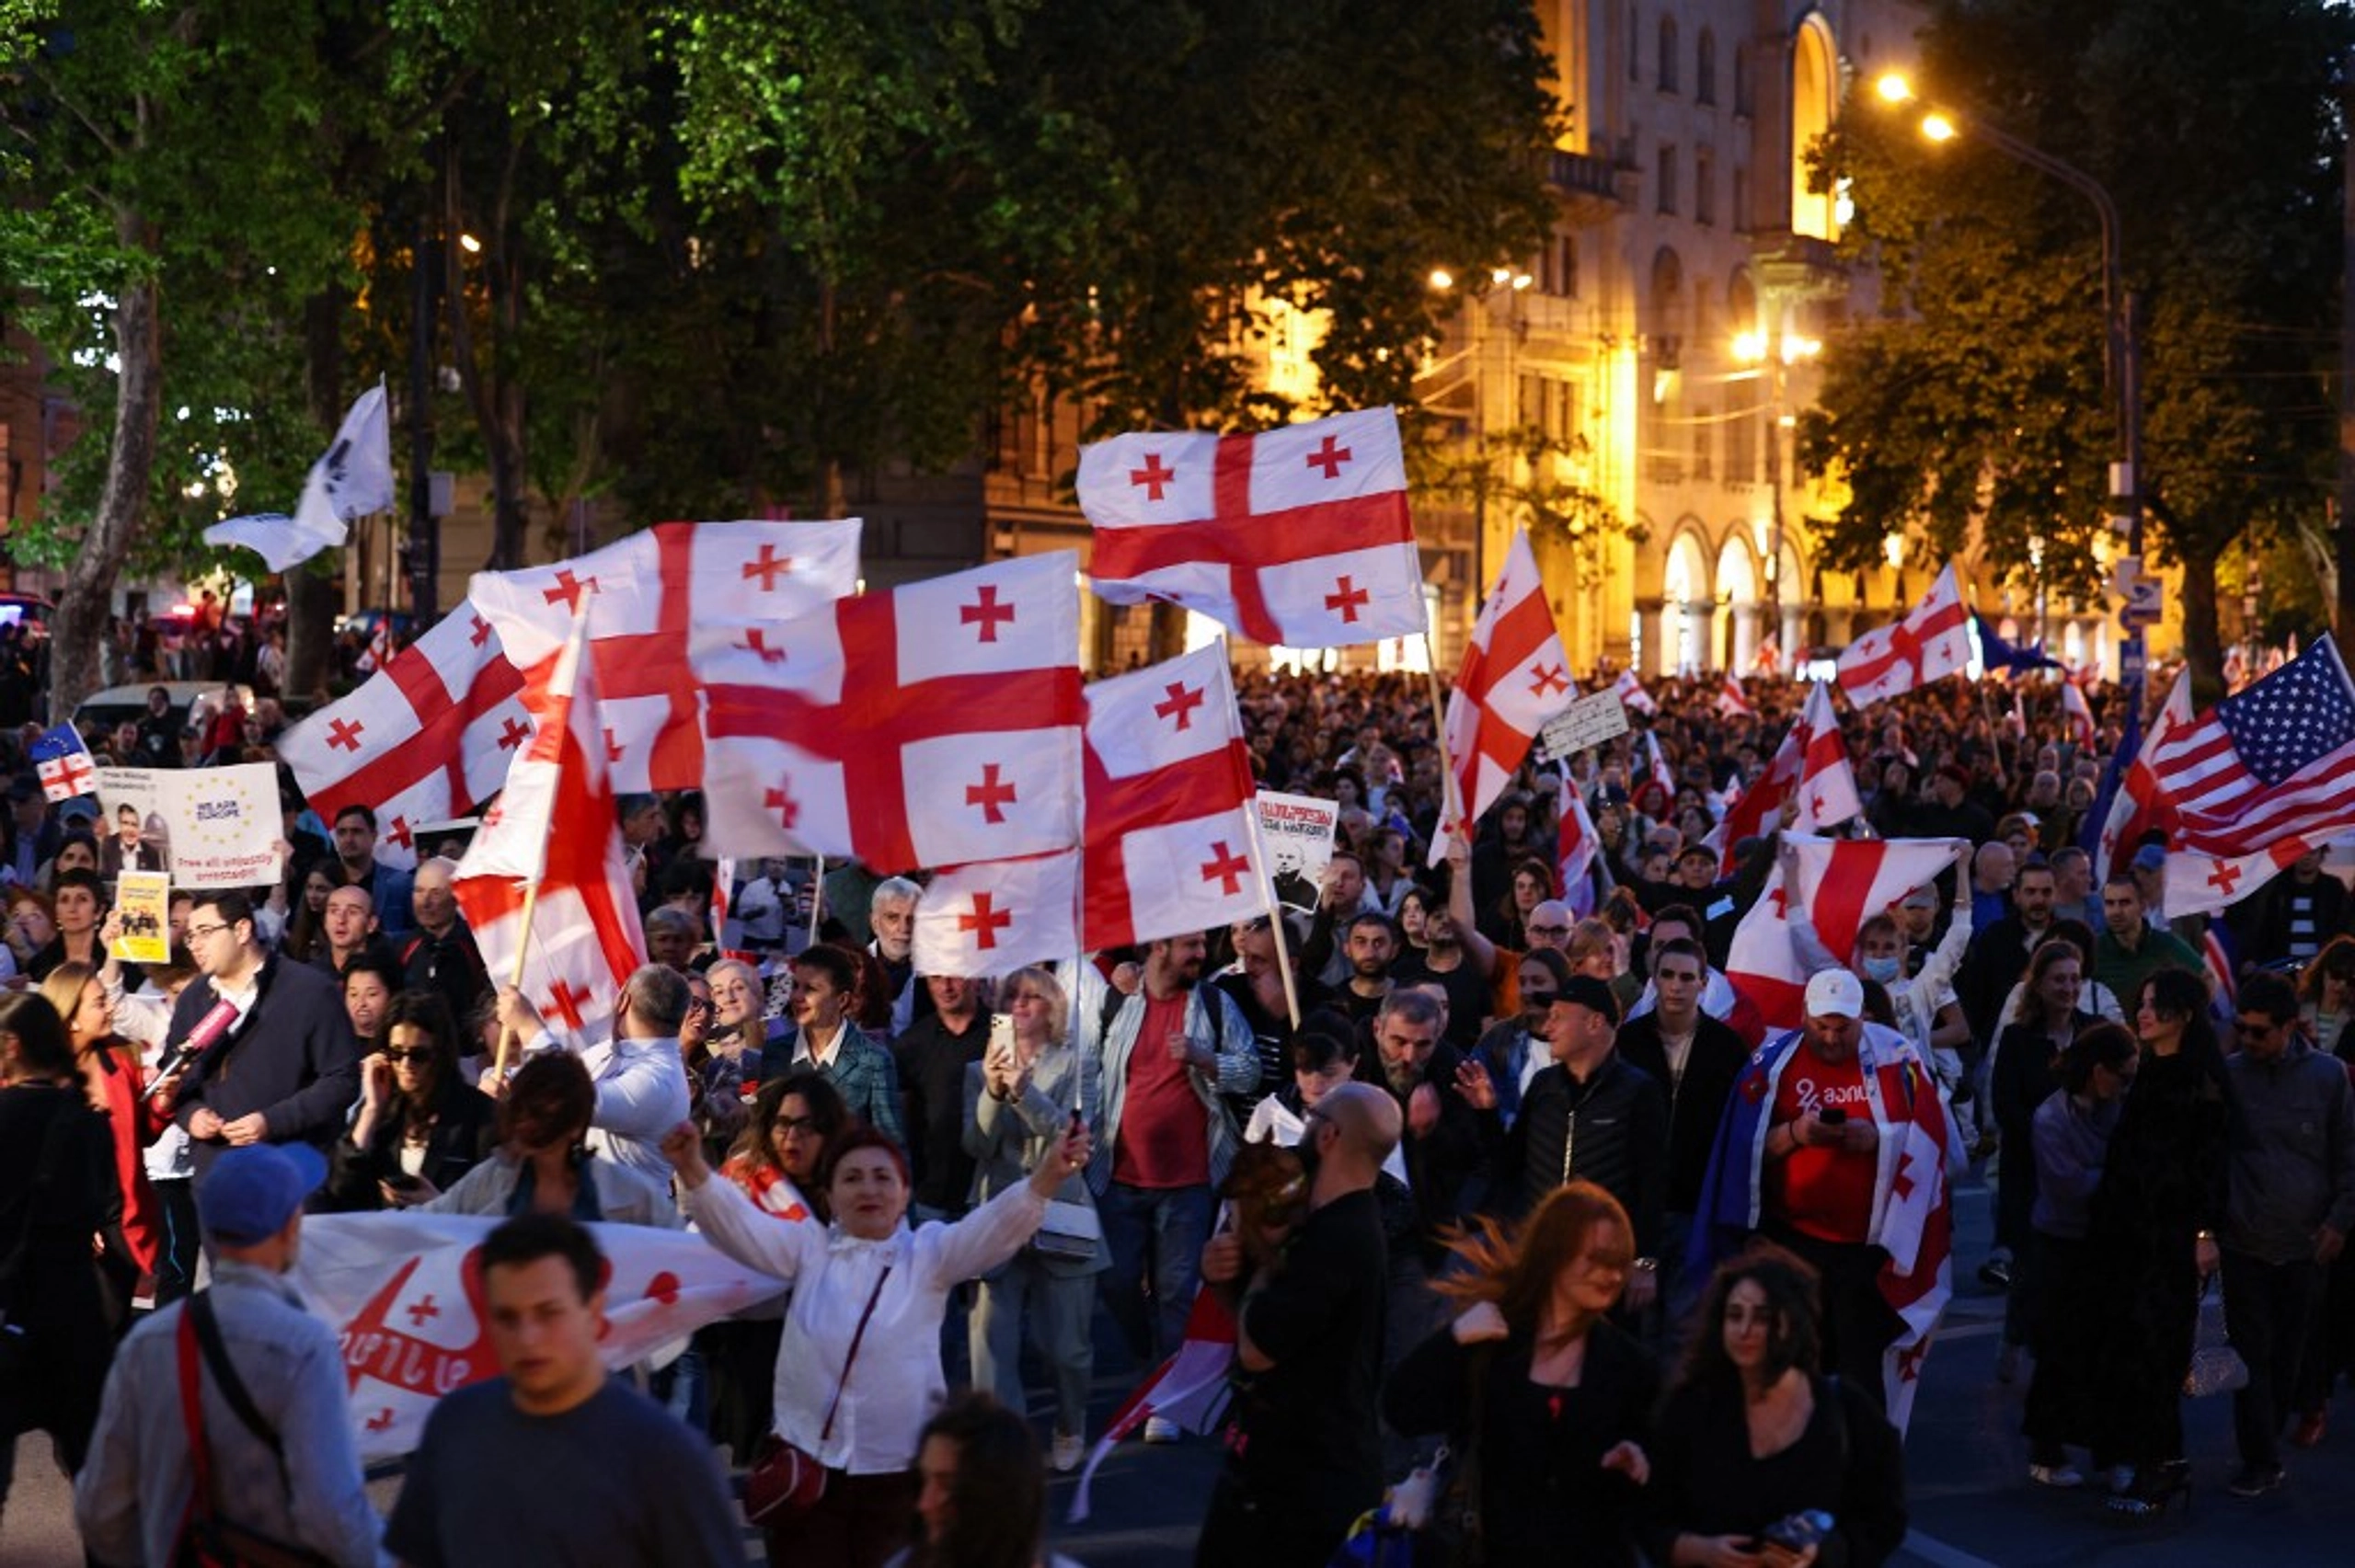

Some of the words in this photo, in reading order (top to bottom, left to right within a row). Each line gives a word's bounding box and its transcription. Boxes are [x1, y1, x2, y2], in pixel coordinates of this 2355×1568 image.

[197, 802, 213, 811] WE
[216, 799, 237, 810] ARE
[197, 808, 240, 821] EUROPE
[178, 856, 201, 868] Free
[205, 856, 220, 867] all
[224, 853, 273, 867] unjustly
[1823, 1085, 1870, 1104] მაის
